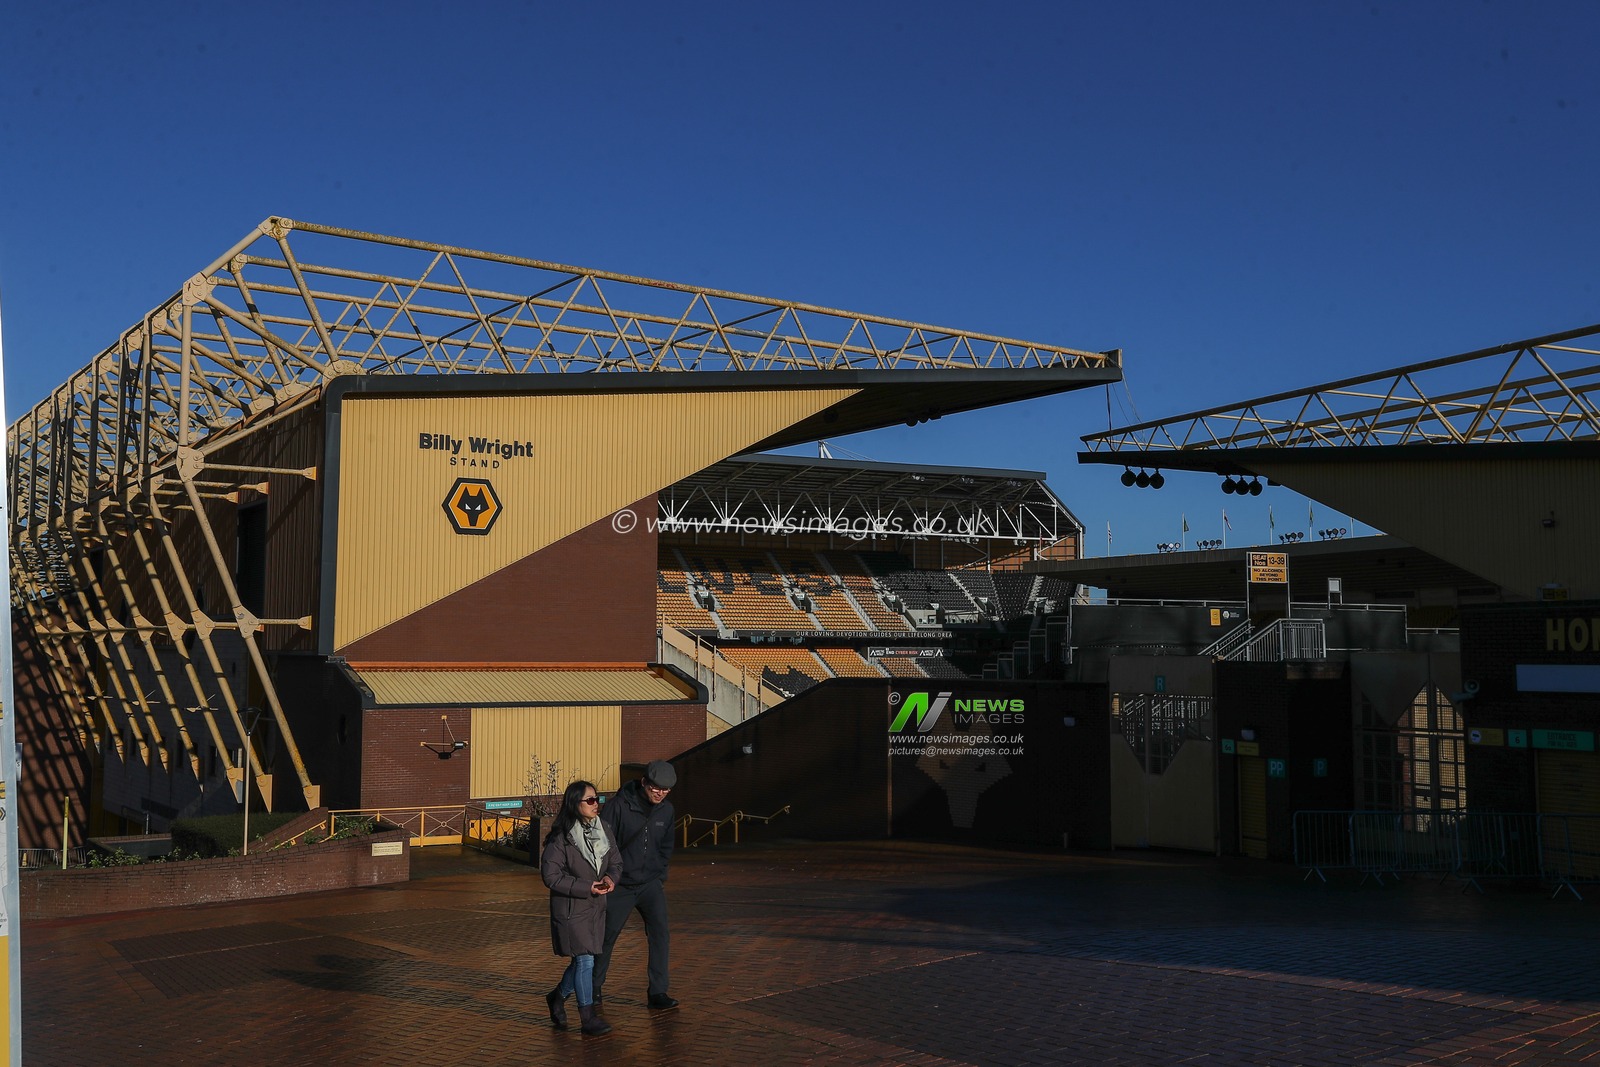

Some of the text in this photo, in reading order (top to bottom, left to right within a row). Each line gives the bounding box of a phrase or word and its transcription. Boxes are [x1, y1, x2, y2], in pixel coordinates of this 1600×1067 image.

[419, 432, 534, 460] Billy Wright
[449, 456, 501, 469] STAND
[1157, 677, 1164, 690] R
[1270, 760, 1283, 776] PP
[1317, 760, 1325, 776] P
